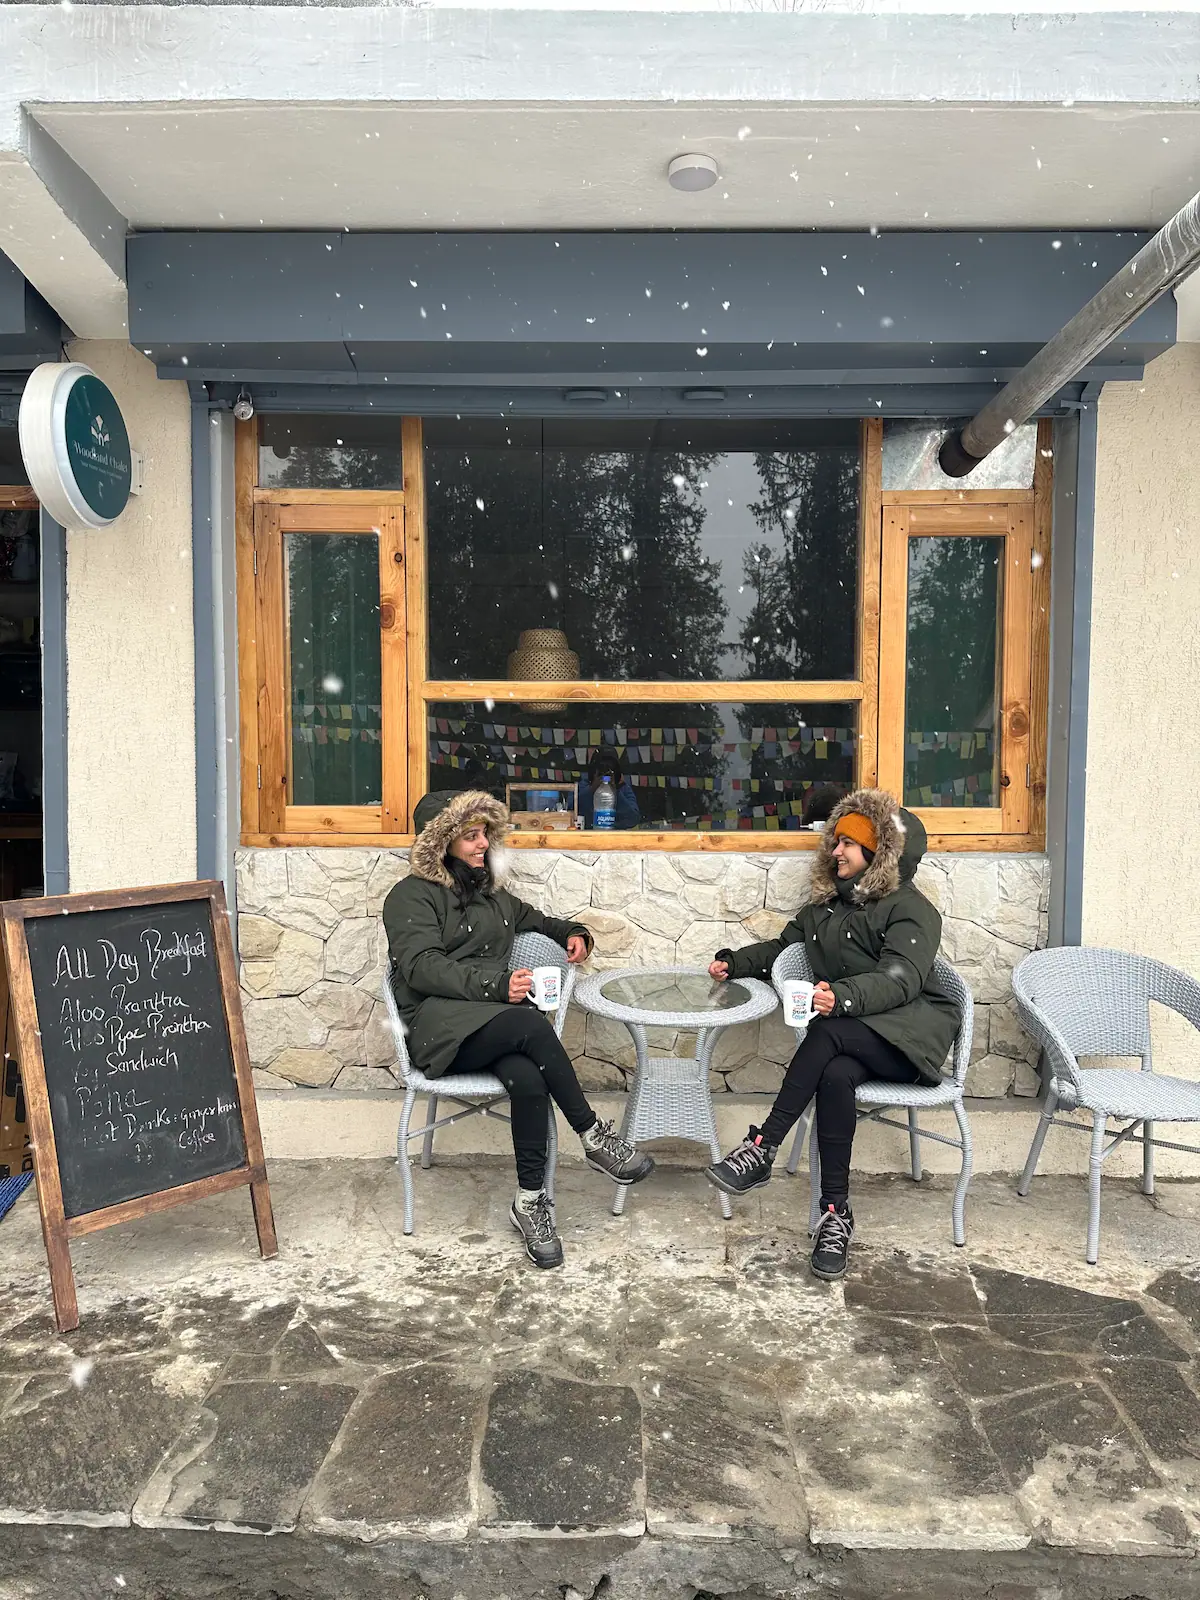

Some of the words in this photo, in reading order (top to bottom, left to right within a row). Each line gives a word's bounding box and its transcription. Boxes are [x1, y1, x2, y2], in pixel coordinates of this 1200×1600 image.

[73, 440, 108, 466] Woodland
[97, 938, 140, 984] Day
[60, 997, 105, 1024] Aloo
[106, 1047, 179, 1076] Sandwich
[178, 1129, 217, 1155] Coffee
